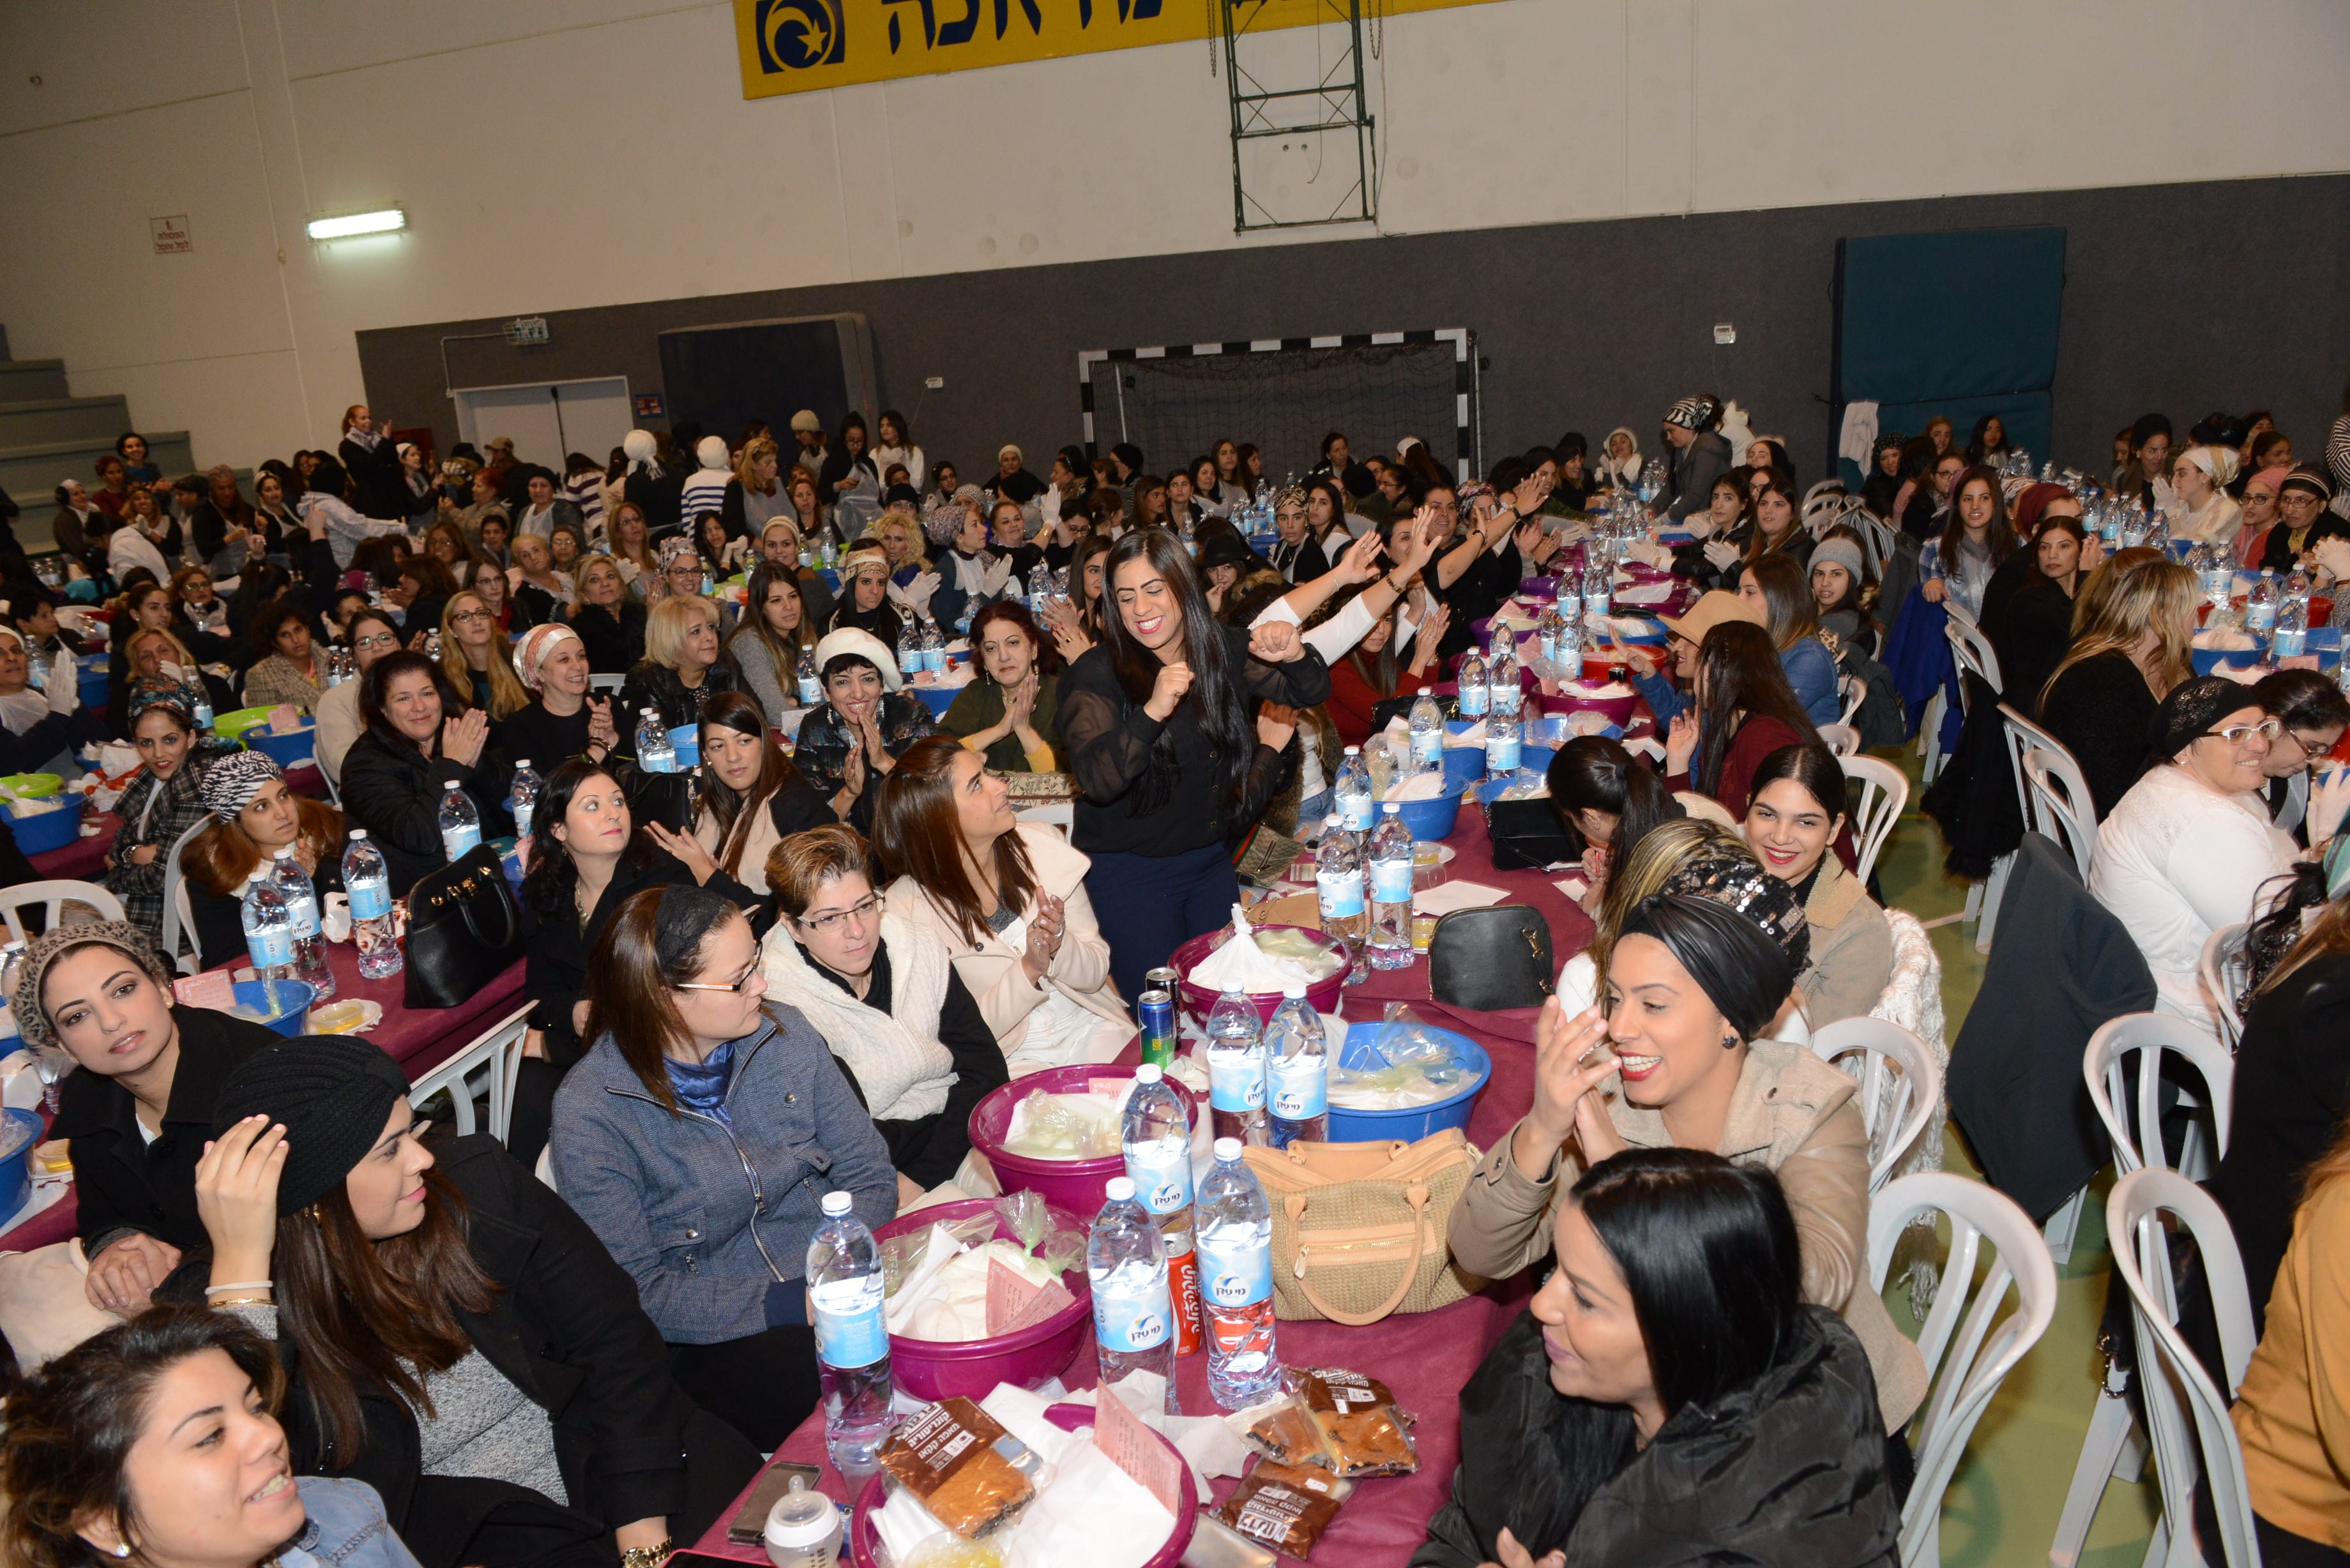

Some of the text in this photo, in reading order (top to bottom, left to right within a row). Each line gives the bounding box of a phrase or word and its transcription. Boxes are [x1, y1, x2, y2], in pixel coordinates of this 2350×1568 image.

[1248, 1092, 1260, 1103] עדן
[1277, 1101, 1290, 1109] עדן
[1155, 1196, 1170, 1206] עדן
[1216, 1287, 1232, 1296] עדן
[1131, 1325, 1161, 1342] מי עדן
[907, 1411, 950, 1448] קונדיטוריה
[937, 1422, 960, 1443] מאפה
[917, 1440, 940, 1460] קקאו
